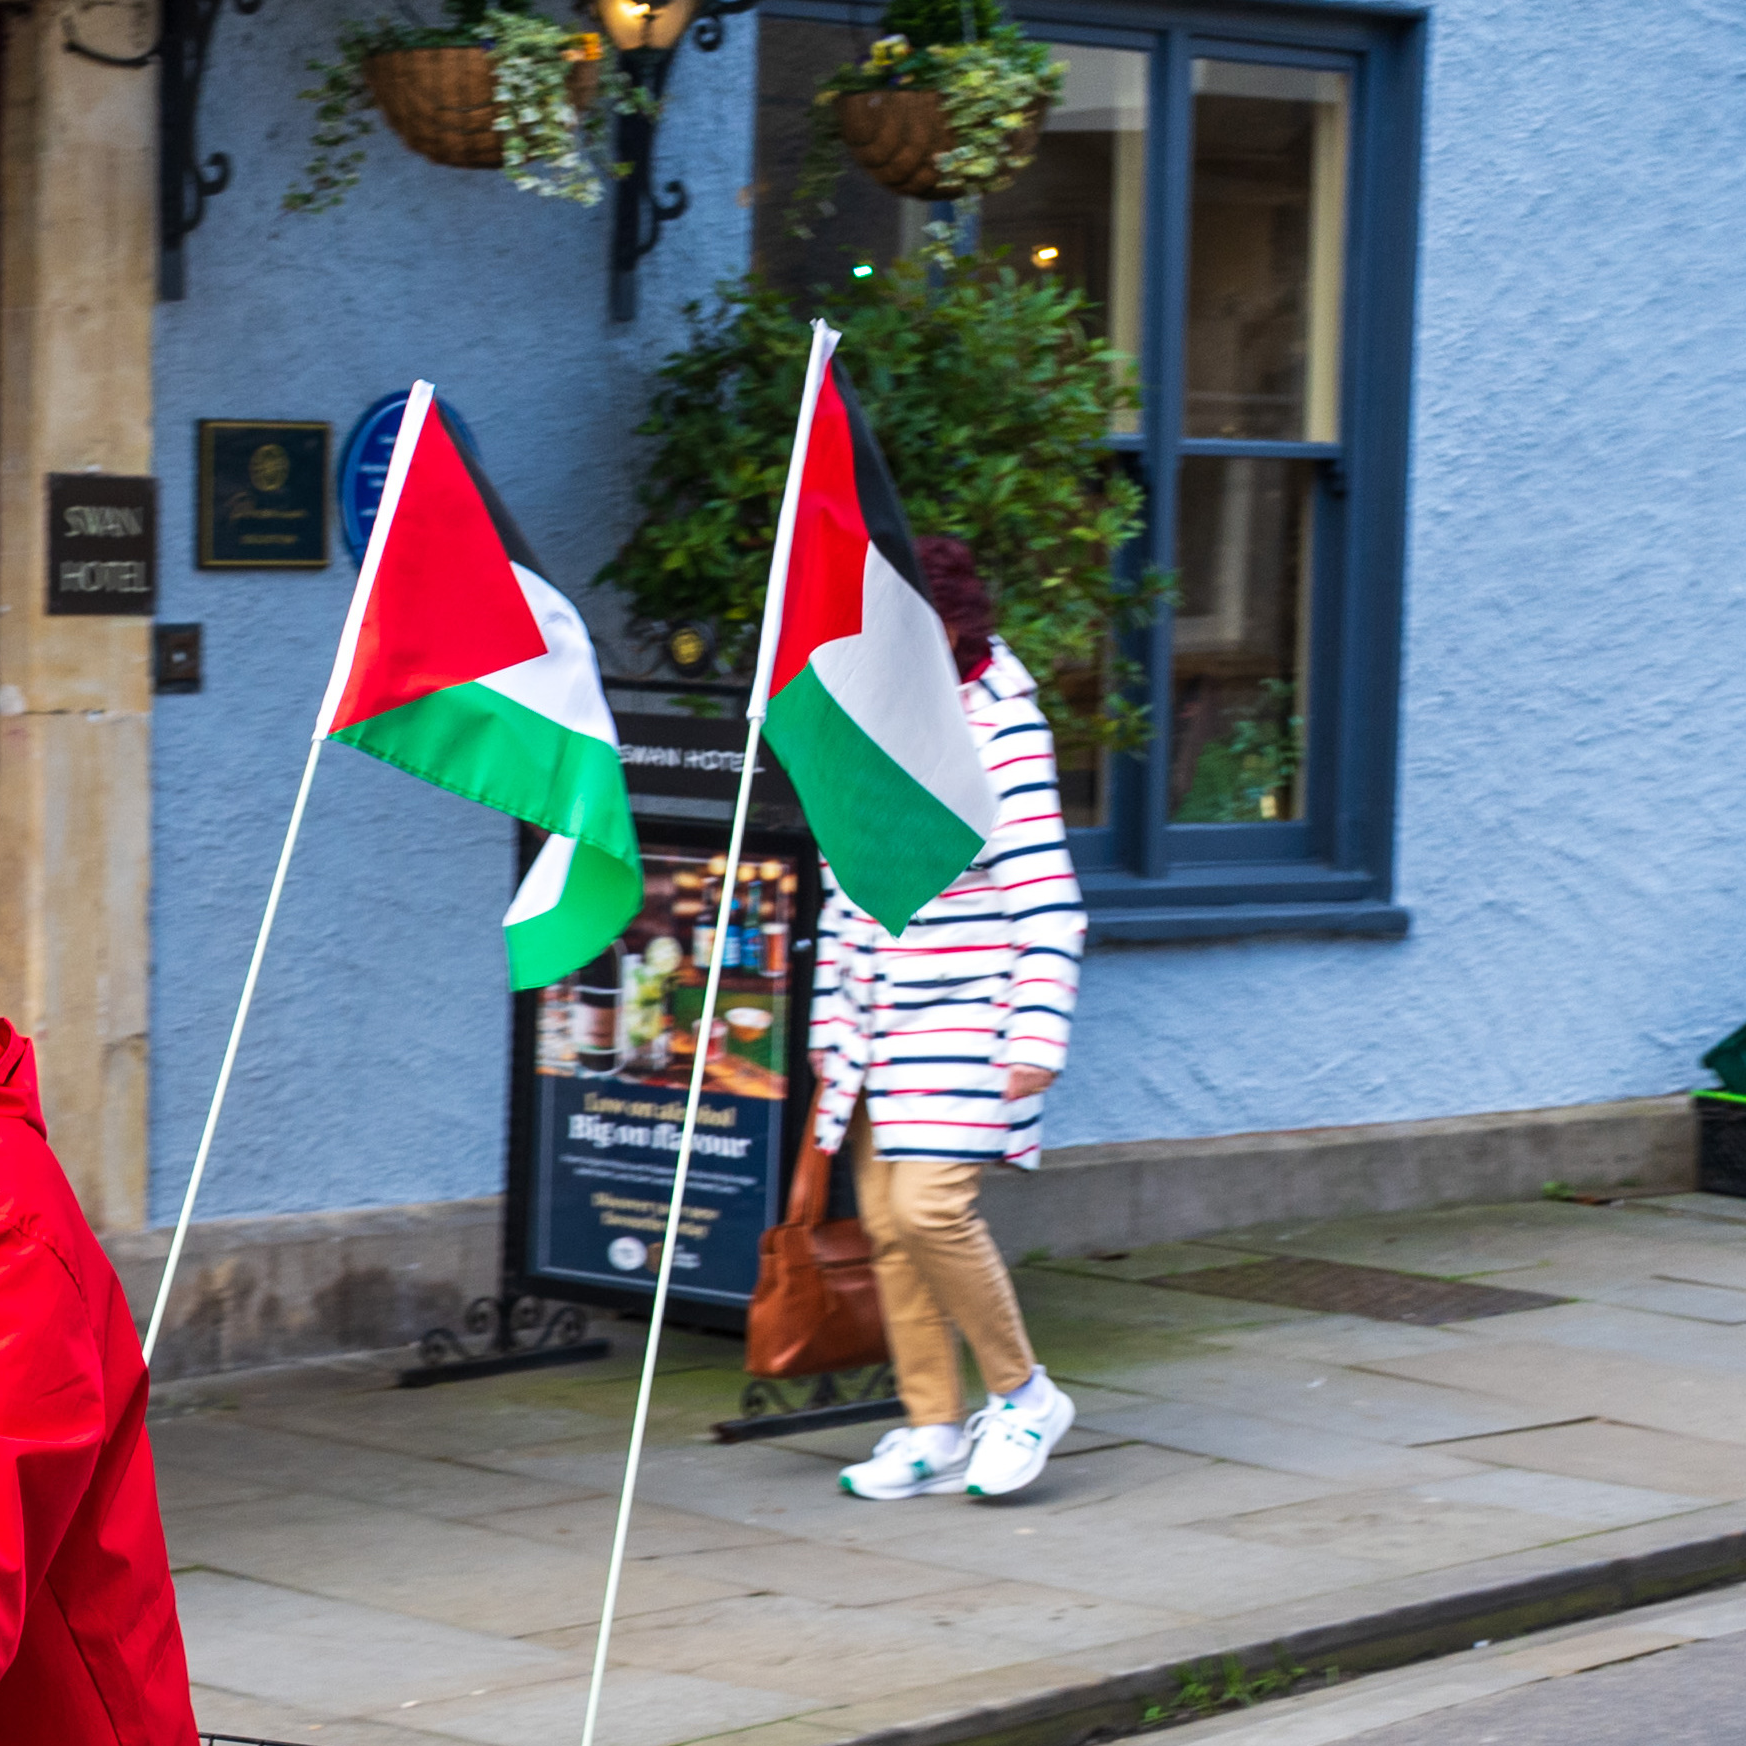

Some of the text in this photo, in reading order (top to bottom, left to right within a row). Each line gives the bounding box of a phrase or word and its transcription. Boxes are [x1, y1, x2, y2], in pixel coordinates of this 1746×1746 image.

[63, 505, 145, 537] SWAN
[60, 560, 152, 592] HOTEL
[568, 1114, 616, 1149] Big
[617, 1124, 651, 1147] on
